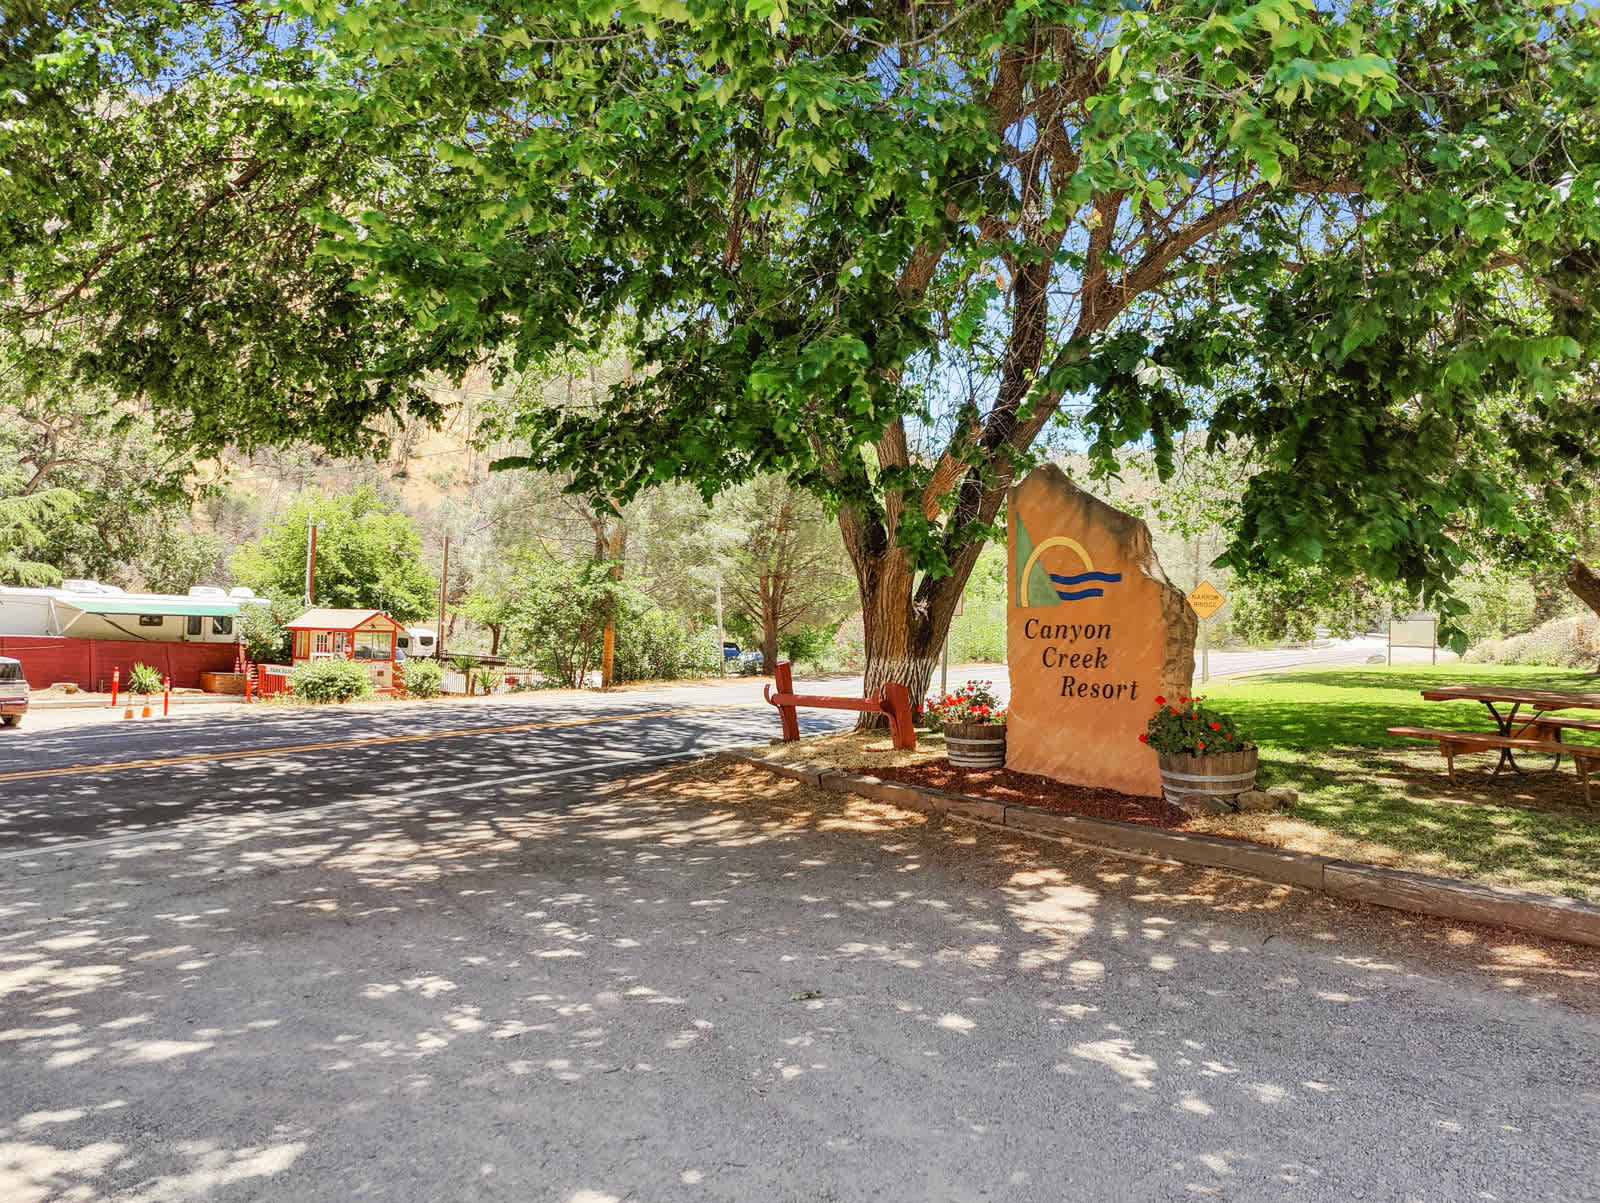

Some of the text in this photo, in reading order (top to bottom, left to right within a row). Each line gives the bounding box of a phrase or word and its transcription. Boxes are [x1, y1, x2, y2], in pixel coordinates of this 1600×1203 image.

[1024, 617, 1112, 643] Canyon
[1042, 646, 1109, 669] Creek
[1060, 675, 1139, 701] Resort
